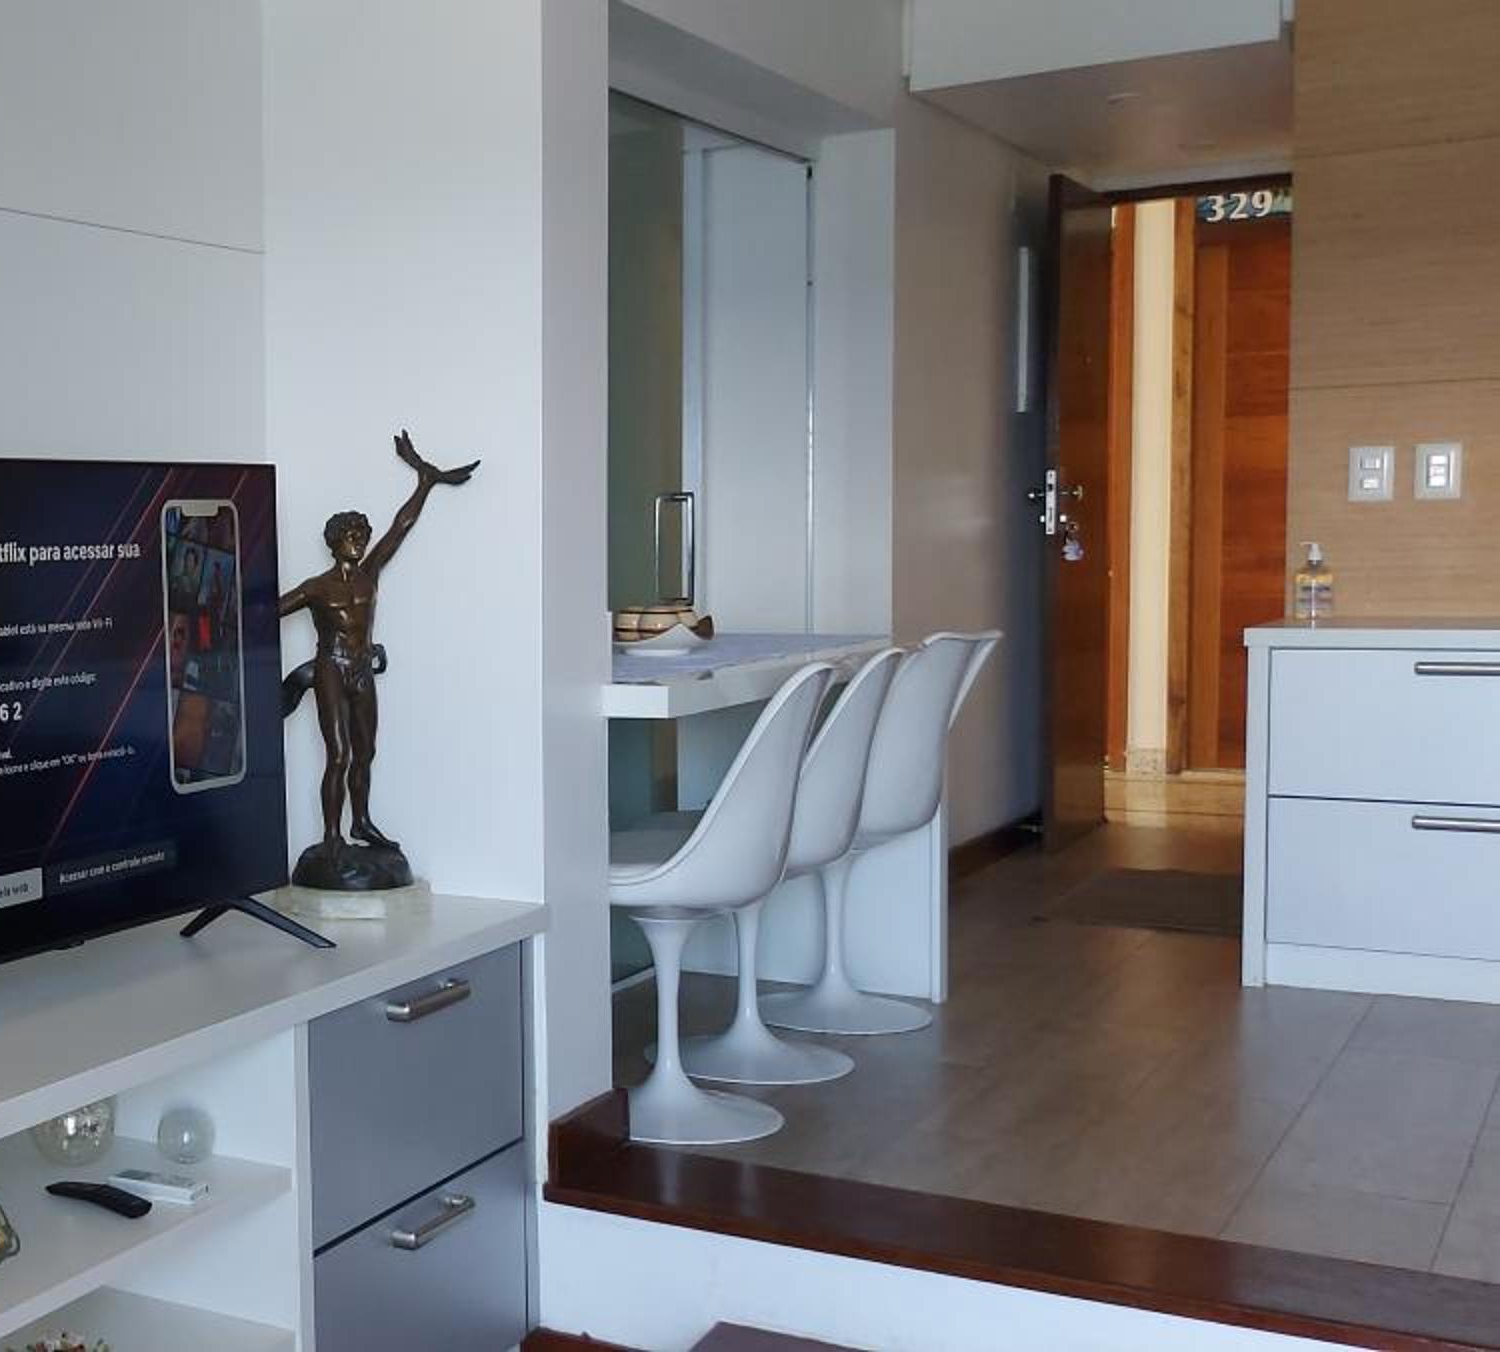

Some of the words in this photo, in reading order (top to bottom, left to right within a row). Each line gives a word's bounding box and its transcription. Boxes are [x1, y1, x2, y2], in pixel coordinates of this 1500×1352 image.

[1206, 190, 1272, 222] 329
[29, 545, 61, 567] para
[63, 544, 114, 561] acessar
[117, 543, 140, 559] sua
